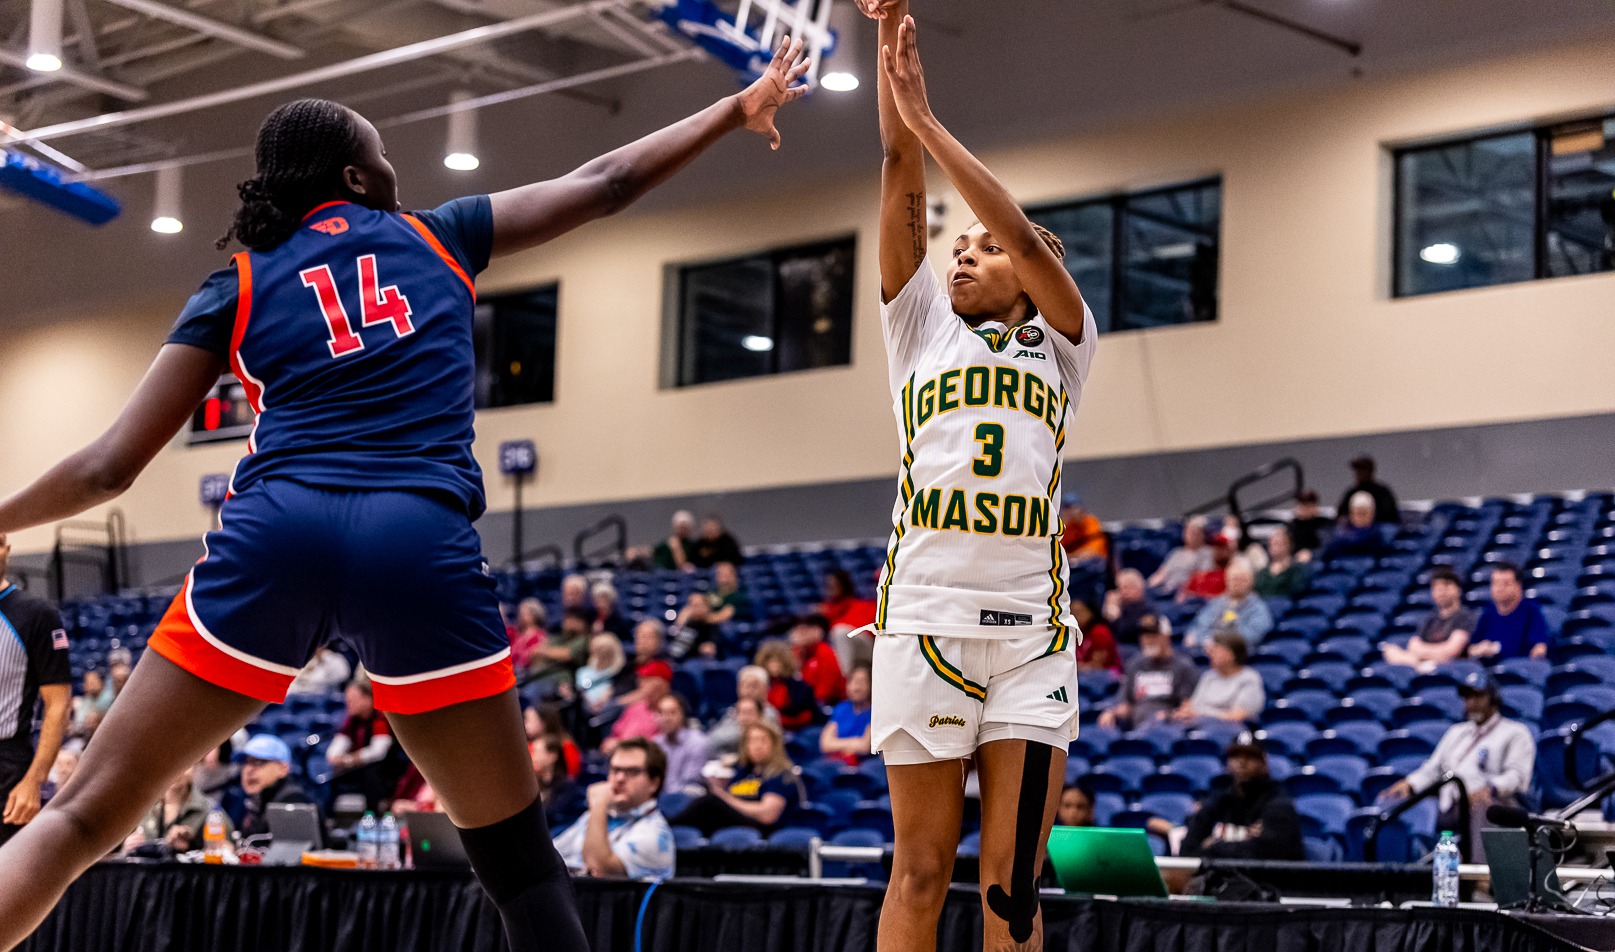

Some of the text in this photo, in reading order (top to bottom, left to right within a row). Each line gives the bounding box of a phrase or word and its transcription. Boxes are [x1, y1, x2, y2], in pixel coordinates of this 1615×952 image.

[299, 253, 416, 359] 14
[1013, 350, 1046, 360] A10
[916, 365, 1059, 438] GEORGE
[971, 421, 1006, 479] 3
[909, 487, 1050, 538] MASON
[928, 714, 966, 728] Patriots
